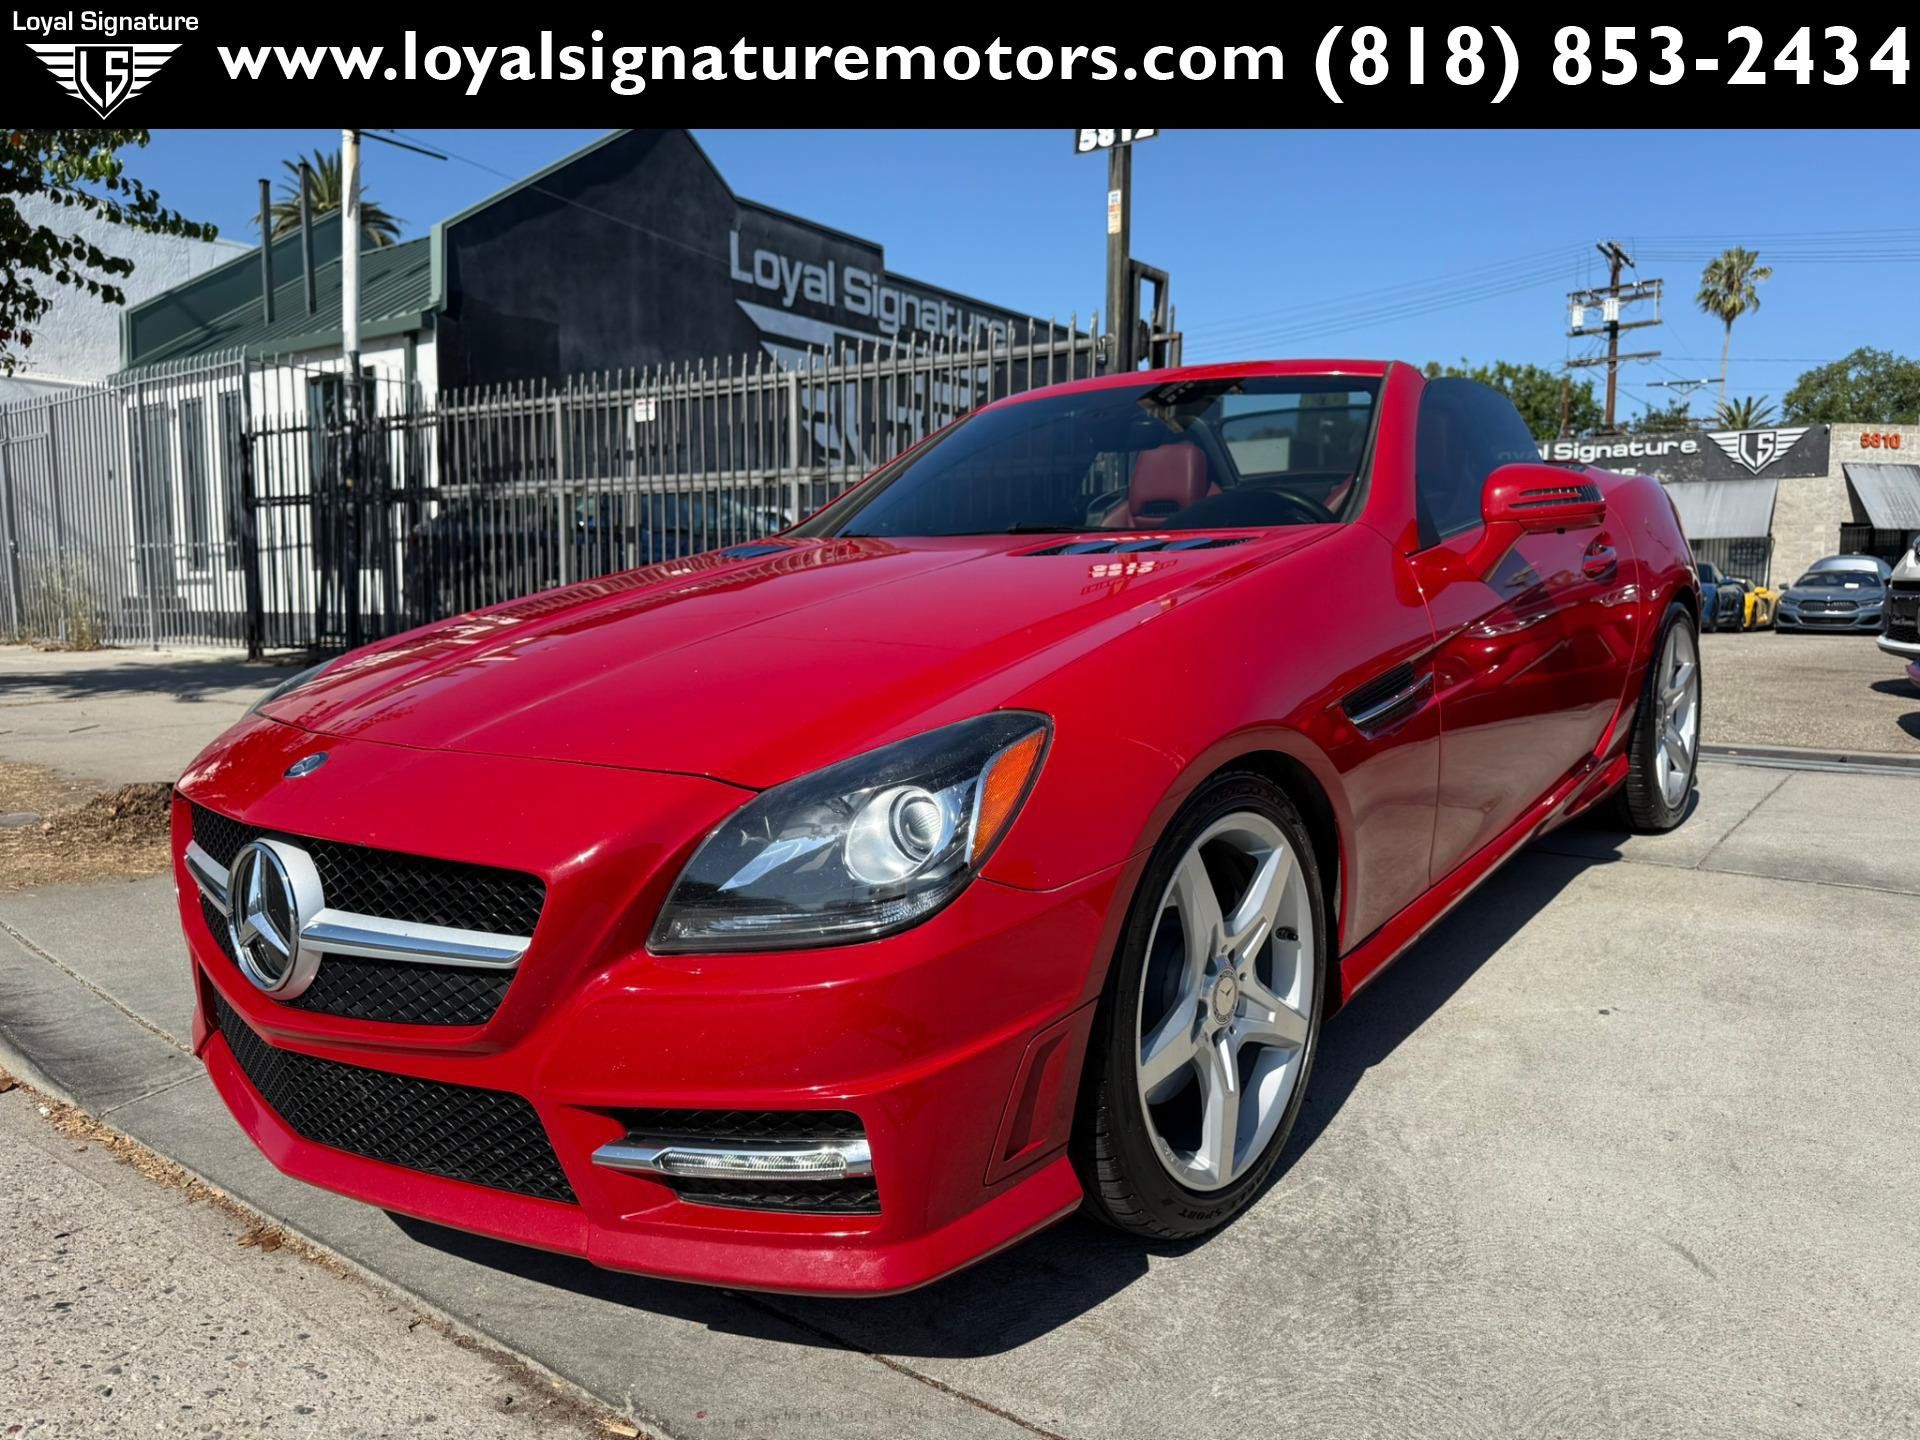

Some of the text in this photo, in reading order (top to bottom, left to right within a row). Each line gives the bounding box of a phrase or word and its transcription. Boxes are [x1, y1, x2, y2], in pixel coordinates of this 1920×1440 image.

[729, 230, 1007, 348] Loyal Signature
[1553, 439, 1698, 464] Signature
